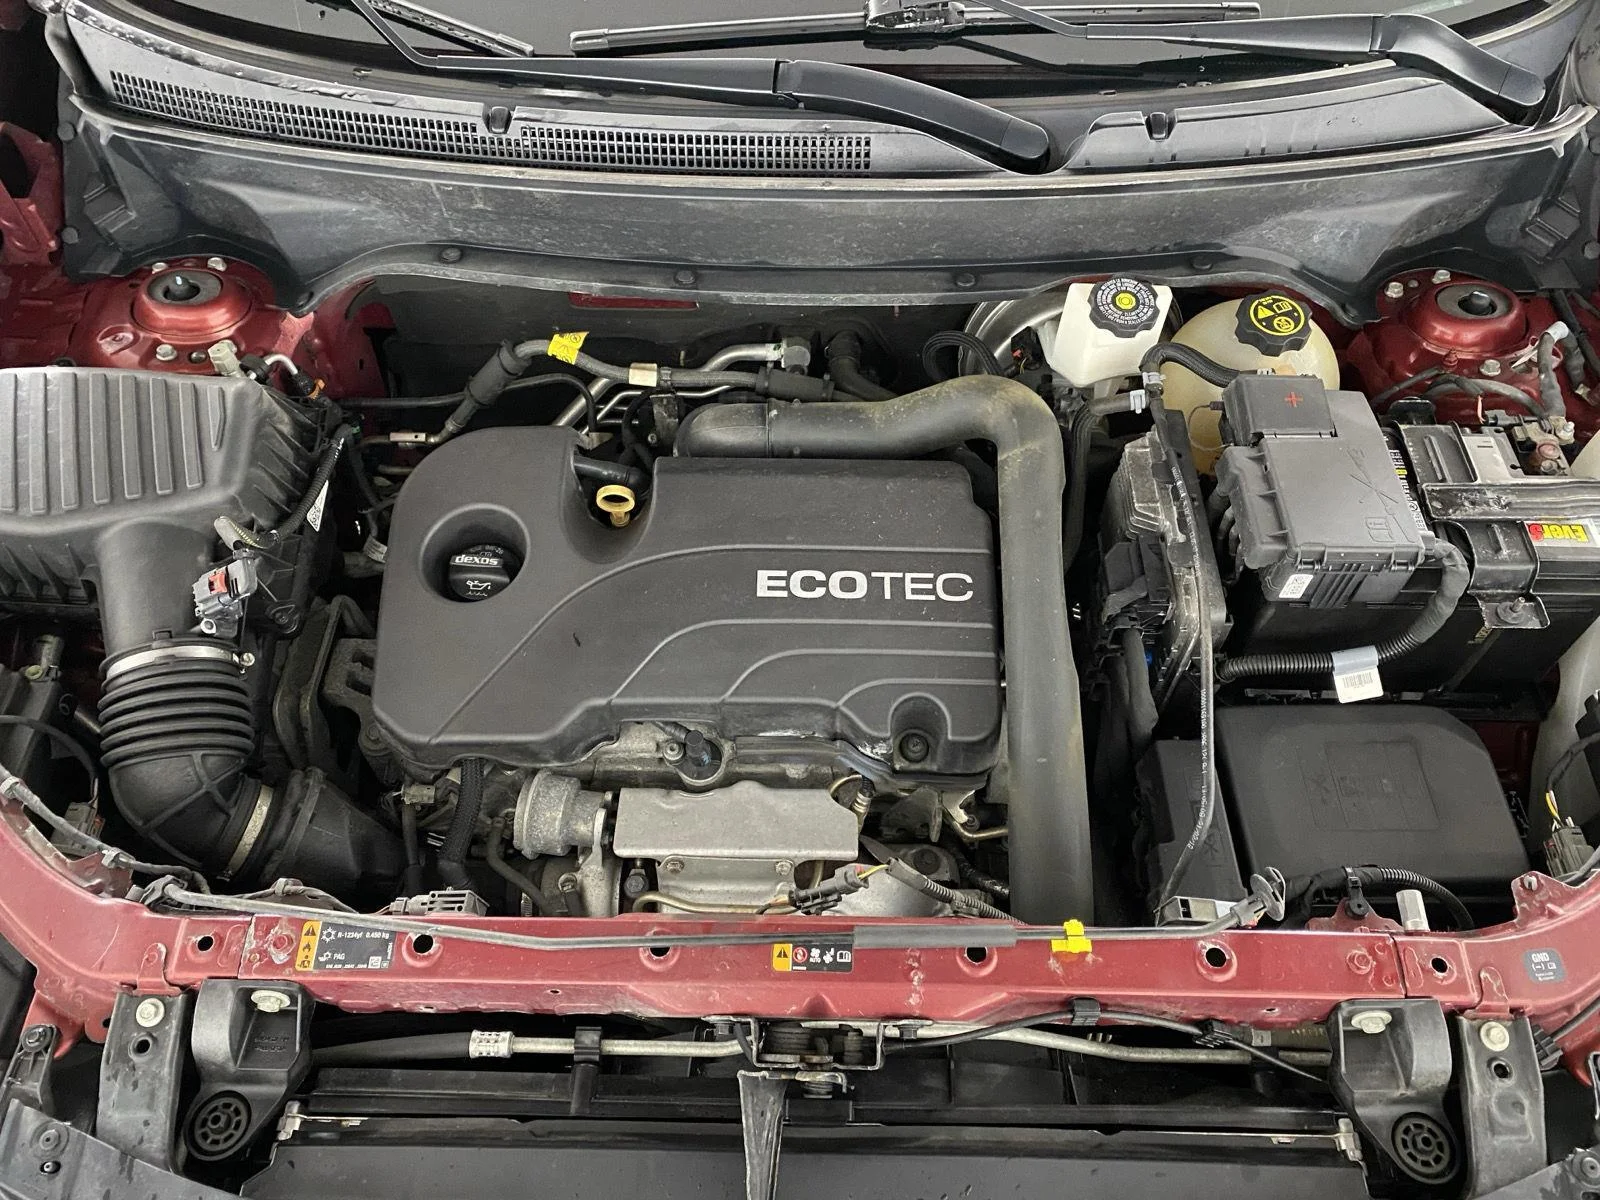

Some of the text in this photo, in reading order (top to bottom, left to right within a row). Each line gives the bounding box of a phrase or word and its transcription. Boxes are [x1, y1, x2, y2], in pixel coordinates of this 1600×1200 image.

[1528, 523, 1588, 542] EverS
[455, 554, 499, 566] dexos
[756, 569, 974, 602] ECOTEC
[382, 931, 390, 940] kg
[1531, 952, 1550, 963] GND
